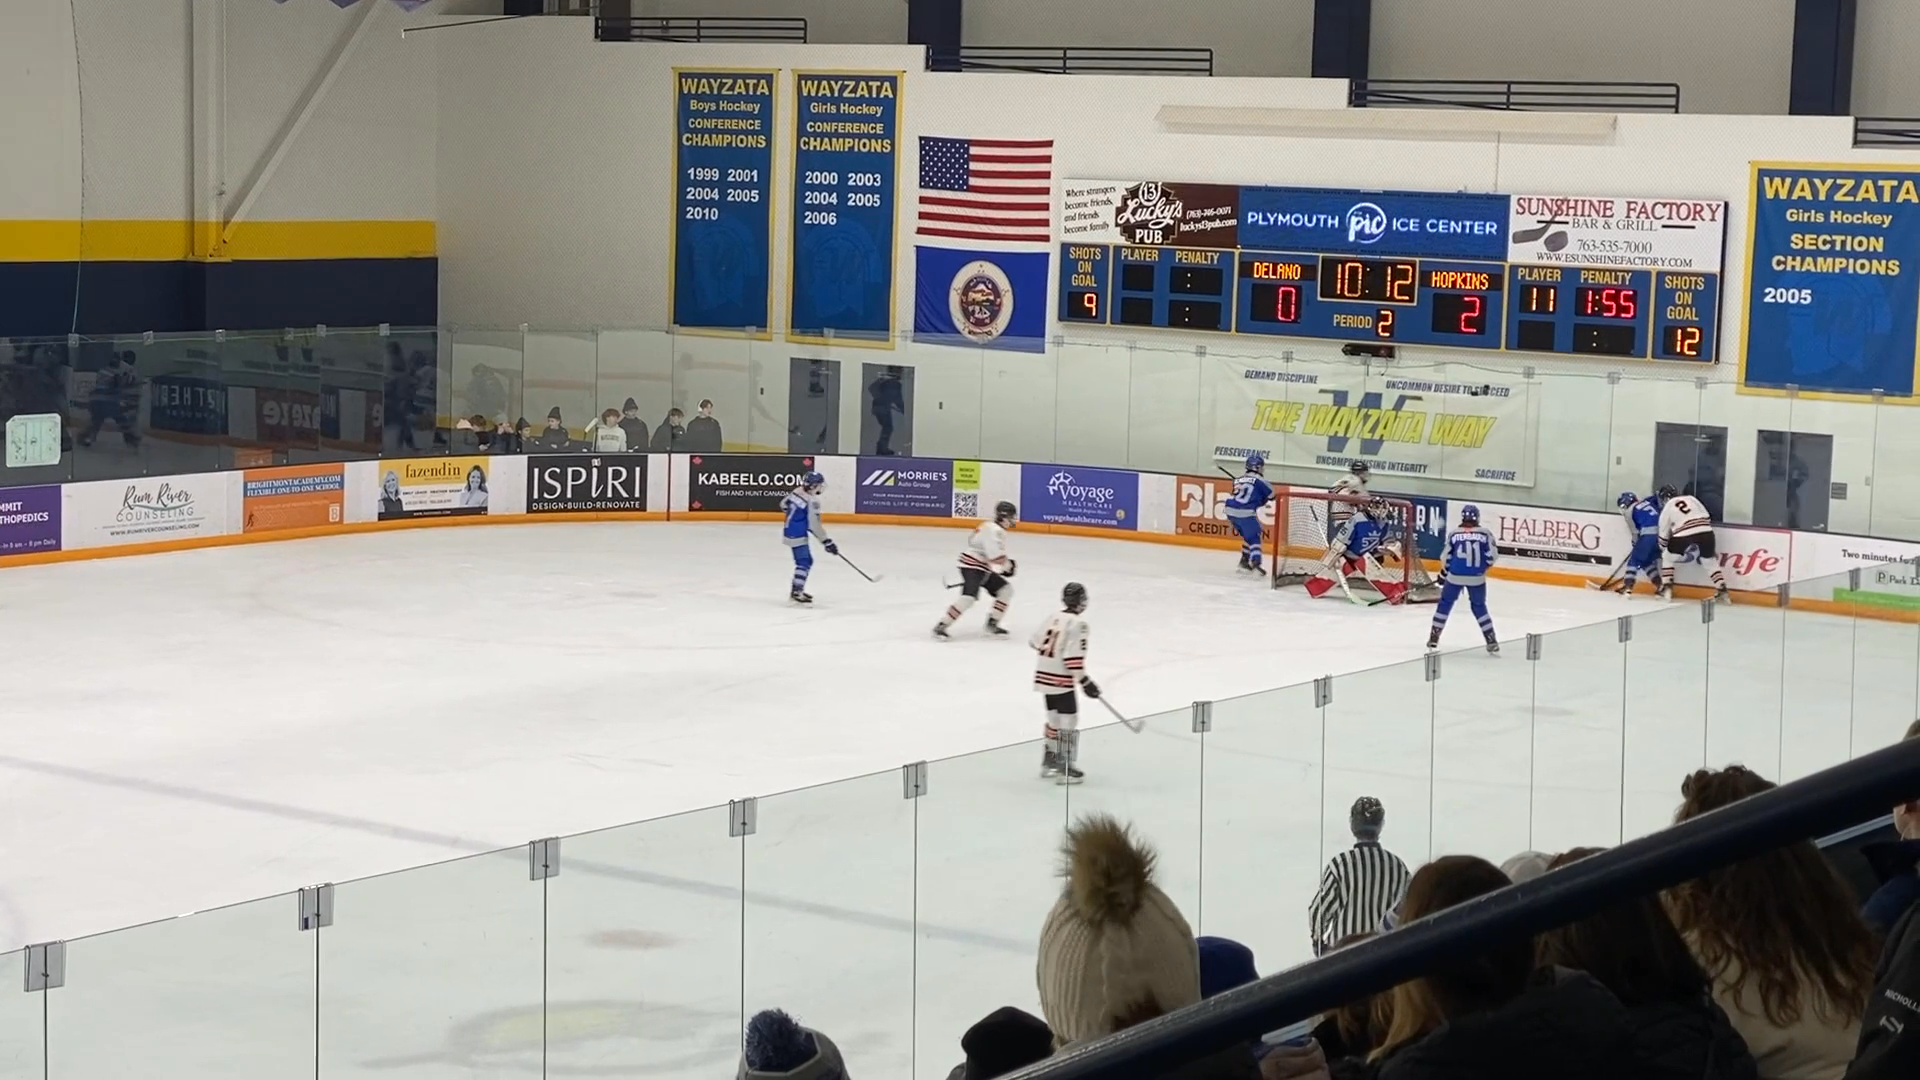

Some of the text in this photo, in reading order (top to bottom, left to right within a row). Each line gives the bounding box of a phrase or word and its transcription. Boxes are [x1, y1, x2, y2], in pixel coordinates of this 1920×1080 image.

[681, 78, 770, 96] WAYZATA
[801, 80, 894, 99] WAYZATA
[690, 100, 761, 115] Boys Hockey
[810, 102, 883, 117] Girls Hockey
[688, 118, 762, 131] CONFERENCE
[806, 121, 884, 134] CONFERENCE
[682, 133, 767, 149] CHAMPIONS
[800, 137, 892, 153] CHAMPIONS
[687, 167, 758, 183] 1999 2001
[804, 171, 881, 187] 2000 2003
[686, 187, 760, 203] 2004 2005
[1144, 183, 1157, 200] 13
[1763, 176, 1920, 204] WAYZATA
[804, 191, 881, 208] 2004 2005
[686, 206, 719, 220] 2010
[1064, 212, 1077, 222] and
[1117, 197, 1183, 229] Lucky's
[1516, 197, 1722, 222] SUNSHINE FACTORY
[804, 211, 837, 226] 2006
[1247, 211, 1339, 229] PLYMOUTH
[1347, 209, 1386, 242] pic
[1392, 217, 1498, 236] ICE CENTER
[1572, 218, 1657, 233] BAR & GRILL
[1785, 209, 1893, 228] Girls Hockey
[1135, 229, 1163, 244] PUB
[1790, 232, 1884, 252] SECTION
[1069, 246, 1101, 261] SHOTS
[1577, 239, 1652, 255] 763-535-7000
[1121, 250, 1159, 262] PLAYER
[1175, 250, 1220, 265] PENALTY
[1536, 252, 1692, 268] WWW.ESUNSHINEFACTORY.COM
[1078, 260, 1092, 274] ON
[1253, 261, 1301, 280] DELANO
[1771, 255, 1901, 276] CHAMPIONS
[1071, 274, 1098, 288] GOAL
[1336, 262, 1413, 301] 10:12
[1431, 271, 1489, 290] HOPKINS
[1518, 267, 1562, 283] PLAYER
[1580, 271, 1632, 286] PENALTY
[1665, 275, 1705, 290] SHOTS
[1277, 286, 1296, 322] 0
[1532, 288, 1555, 313] 11
[1587, 289, 1635, 318] 1:55
[1675, 292, 1693, 306] ON
[1763, 287, 1812, 305] 2005
[1084, 293, 1096, 317] 9
[1333, 313, 1373, 329] PERIOD
[1461, 296, 1480, 333] 2
[1667, 306, 1699, 321] GOAL
[1378, 309, 1393, 337] 2
[1675, 328, 1701, 356] 12
[1245, 370, 1319, 385] DEMAND DISCIPLINE
[1386, 380, 1433, 393] UNCOMMON
[1434, 383, 1461, 395] DESIRE
[1251, 399, 1498, 449] THE WAYZATA WAY
[405, 462, 461, 479] fazendin
[1387, 461, 1429, 474] INTEGRITY
[1474, 468, 1517, 481] SACRIFICE
[247, 475, 341, 489] BRIGHTMONTACADEMY.COM
[898, 471, 948, 483] MORRIE'S
[898, 480, 931, 490] Auto Group
[123, 483, 192, 510] Rum River
[247, 488, 276, 497] FLEXIBLE
[315, 483, 341, 491] SCHOOL
[1058, 485, 1114, 504] Voyage
[1062, 500, 1113, 510] HEALTHCARE
[1674, 500, 1692, 515] 2
[116, 507, 194, 523] COUNSELING
[1043, 514, 1118, 525] voyagehealthcare.com
[1189, 521, 1230, 536] CREDIT
[1499, 516, 1601, 550] HALBERG
[1457, 541, 1481, 568] 41
[1841, 549, 1915, 565] Two minutes for
[1889, 575, 1907, 585] Park
